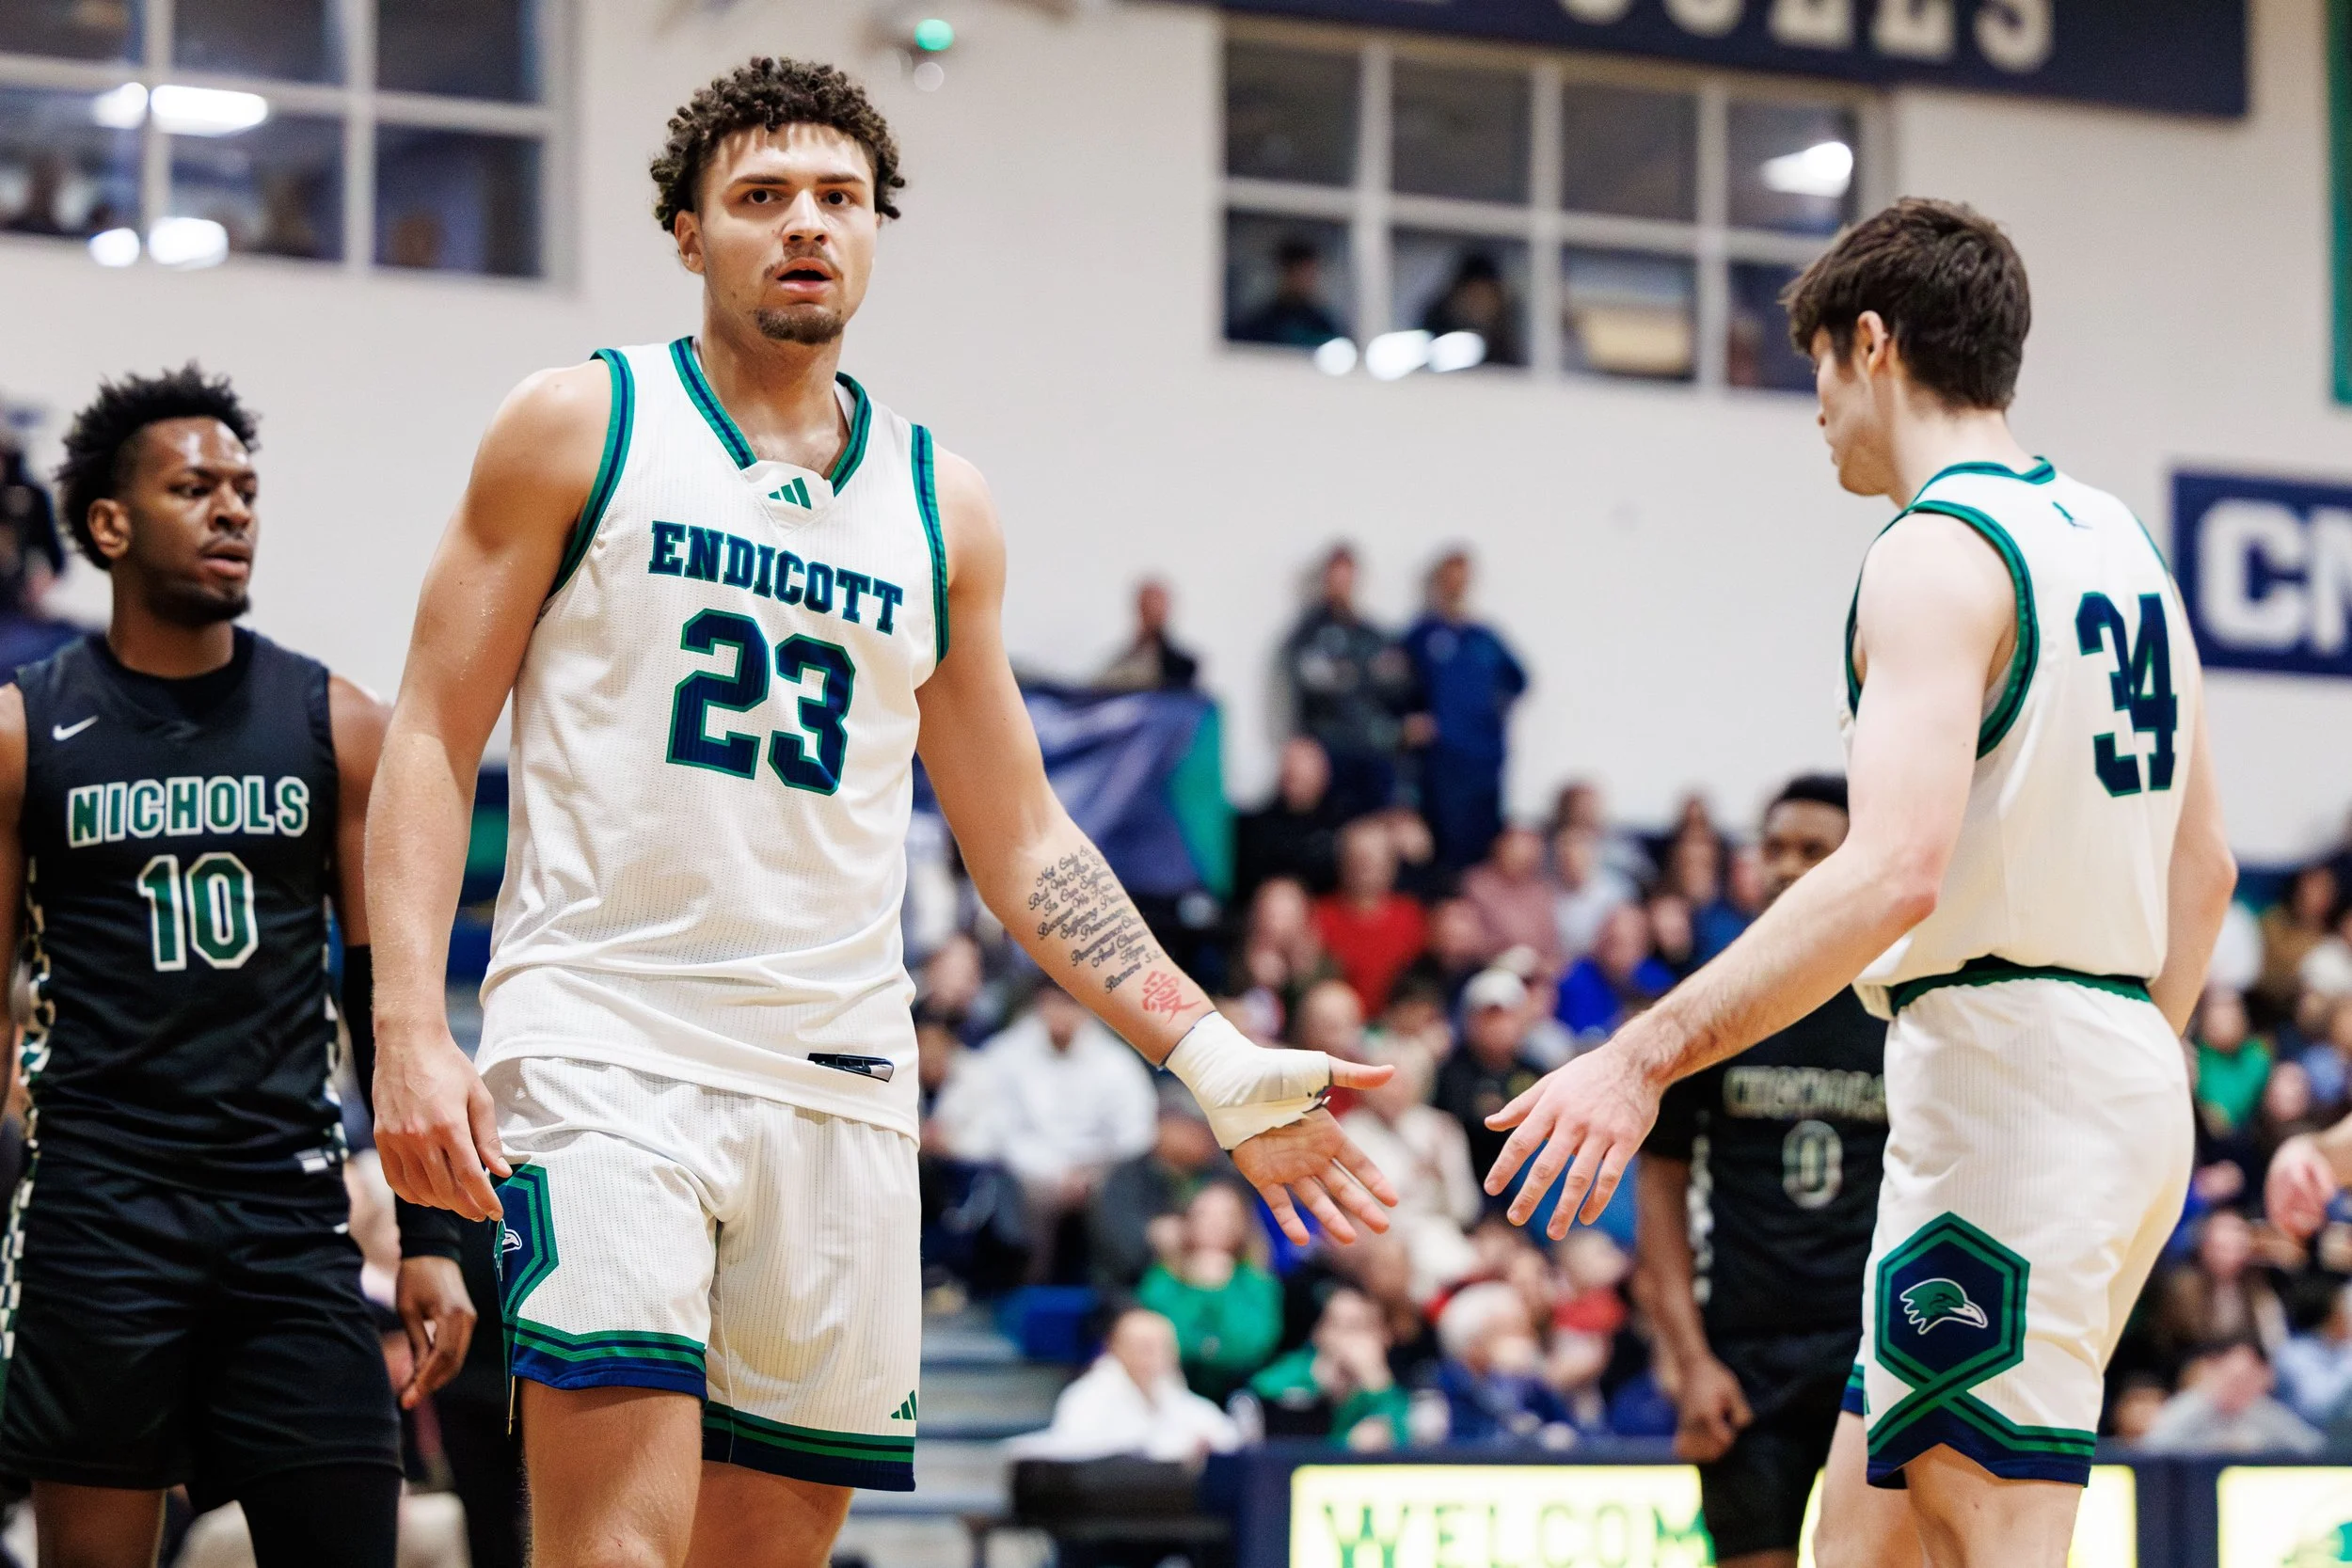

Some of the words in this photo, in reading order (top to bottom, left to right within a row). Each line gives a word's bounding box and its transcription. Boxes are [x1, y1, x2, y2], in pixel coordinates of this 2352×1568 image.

[648, 520, 903, 635] ENDICOTT
[666, 608, 856, 797] 23
[2075, 592, 2177, 798] 34
[68, 775, 310, 847] NICHOLS
[137, 852, 259, 972] 10
[1782, 1119, 1843, 1208] 0
